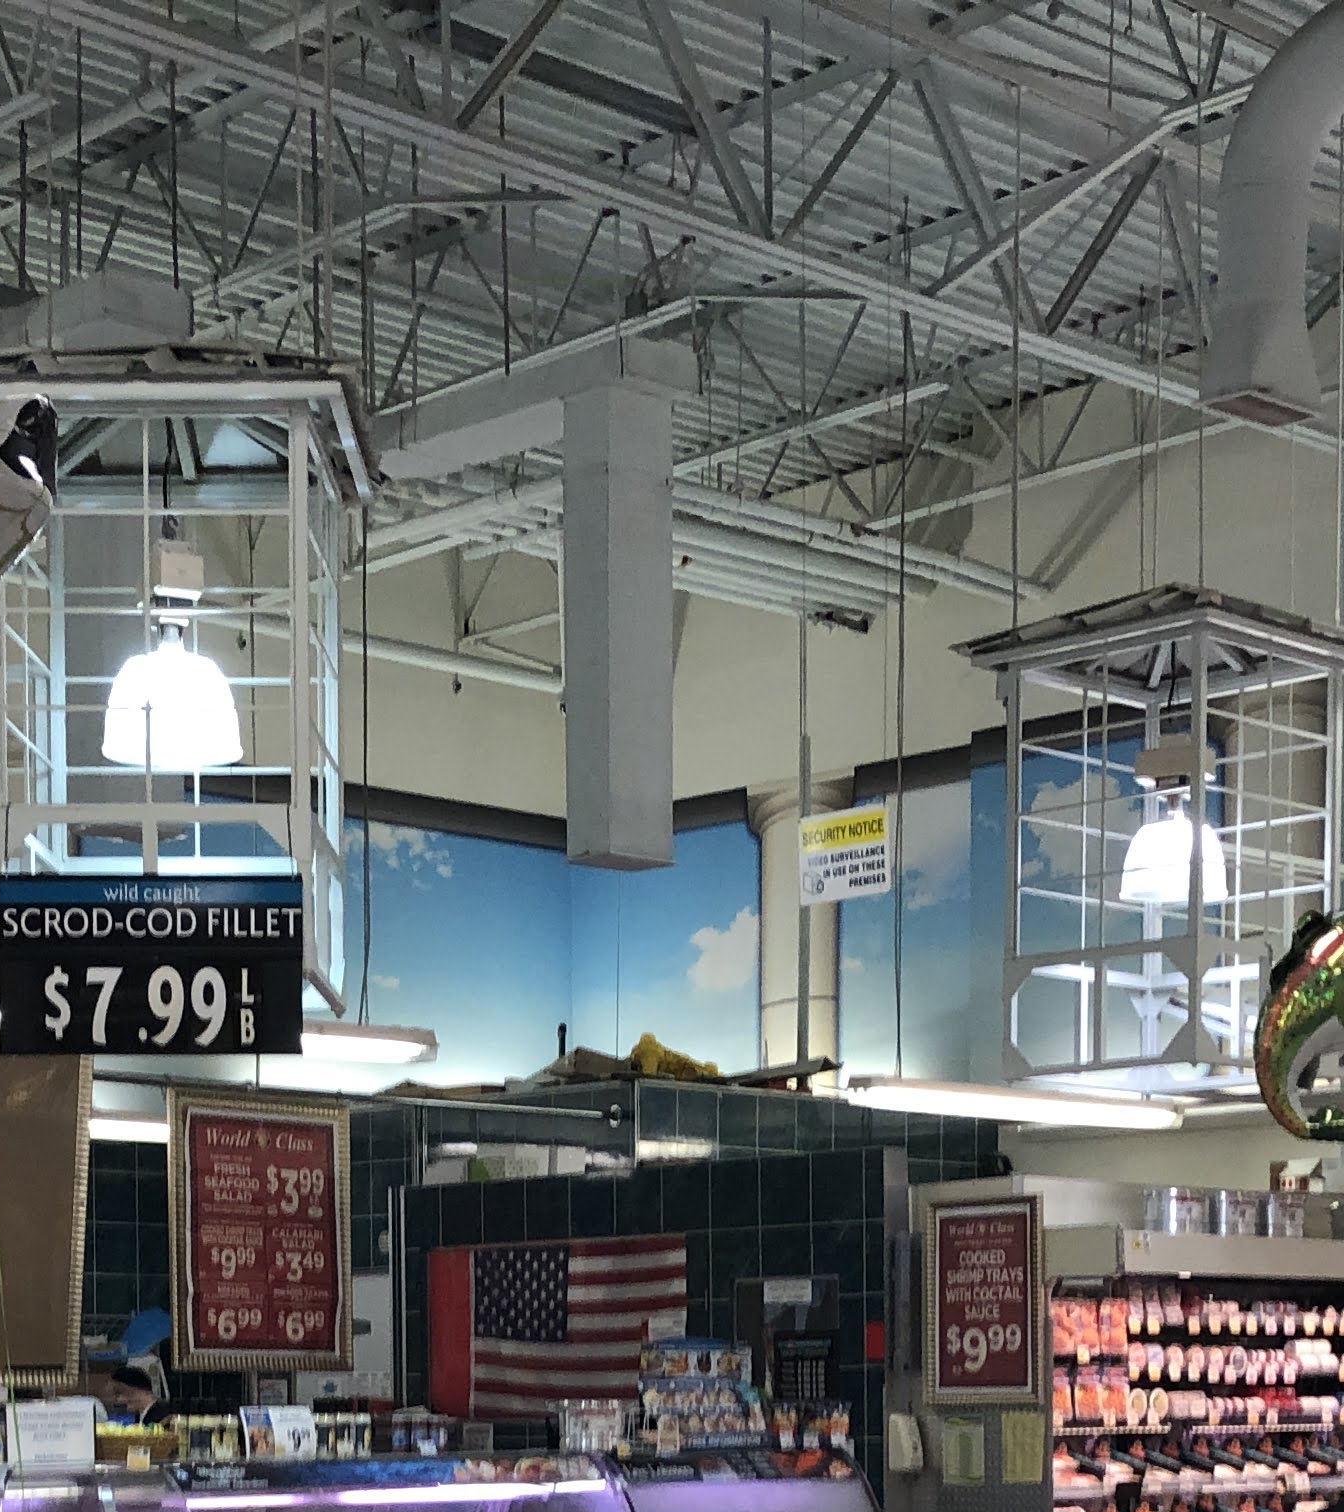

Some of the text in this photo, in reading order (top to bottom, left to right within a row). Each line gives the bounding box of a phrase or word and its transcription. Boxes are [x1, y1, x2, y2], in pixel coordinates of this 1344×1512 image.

[803, 819, 884, 846] SECURITY NOTICE
[103, 883, 202, 906] wild caught
[2, 907, 303, 940] SCROD-COD FILLET
[205, 1127, 314, 1153] World Class
[213, 1162, 252, 1177] FRESH
[204, 1175, 260, 1191] SEAFOOD
[213, 1189, 253, 1204] SALAD
[272, 1227, 324, 1242] CALAMARI
[959, 1249, 1007, 1265] COOKED
[946, 1265, 1025, 1285] SHRIMP TRAYS
[945, 1286, 973, 1304] WITH
[964, 1304, 1002, 1322] SAUCE
